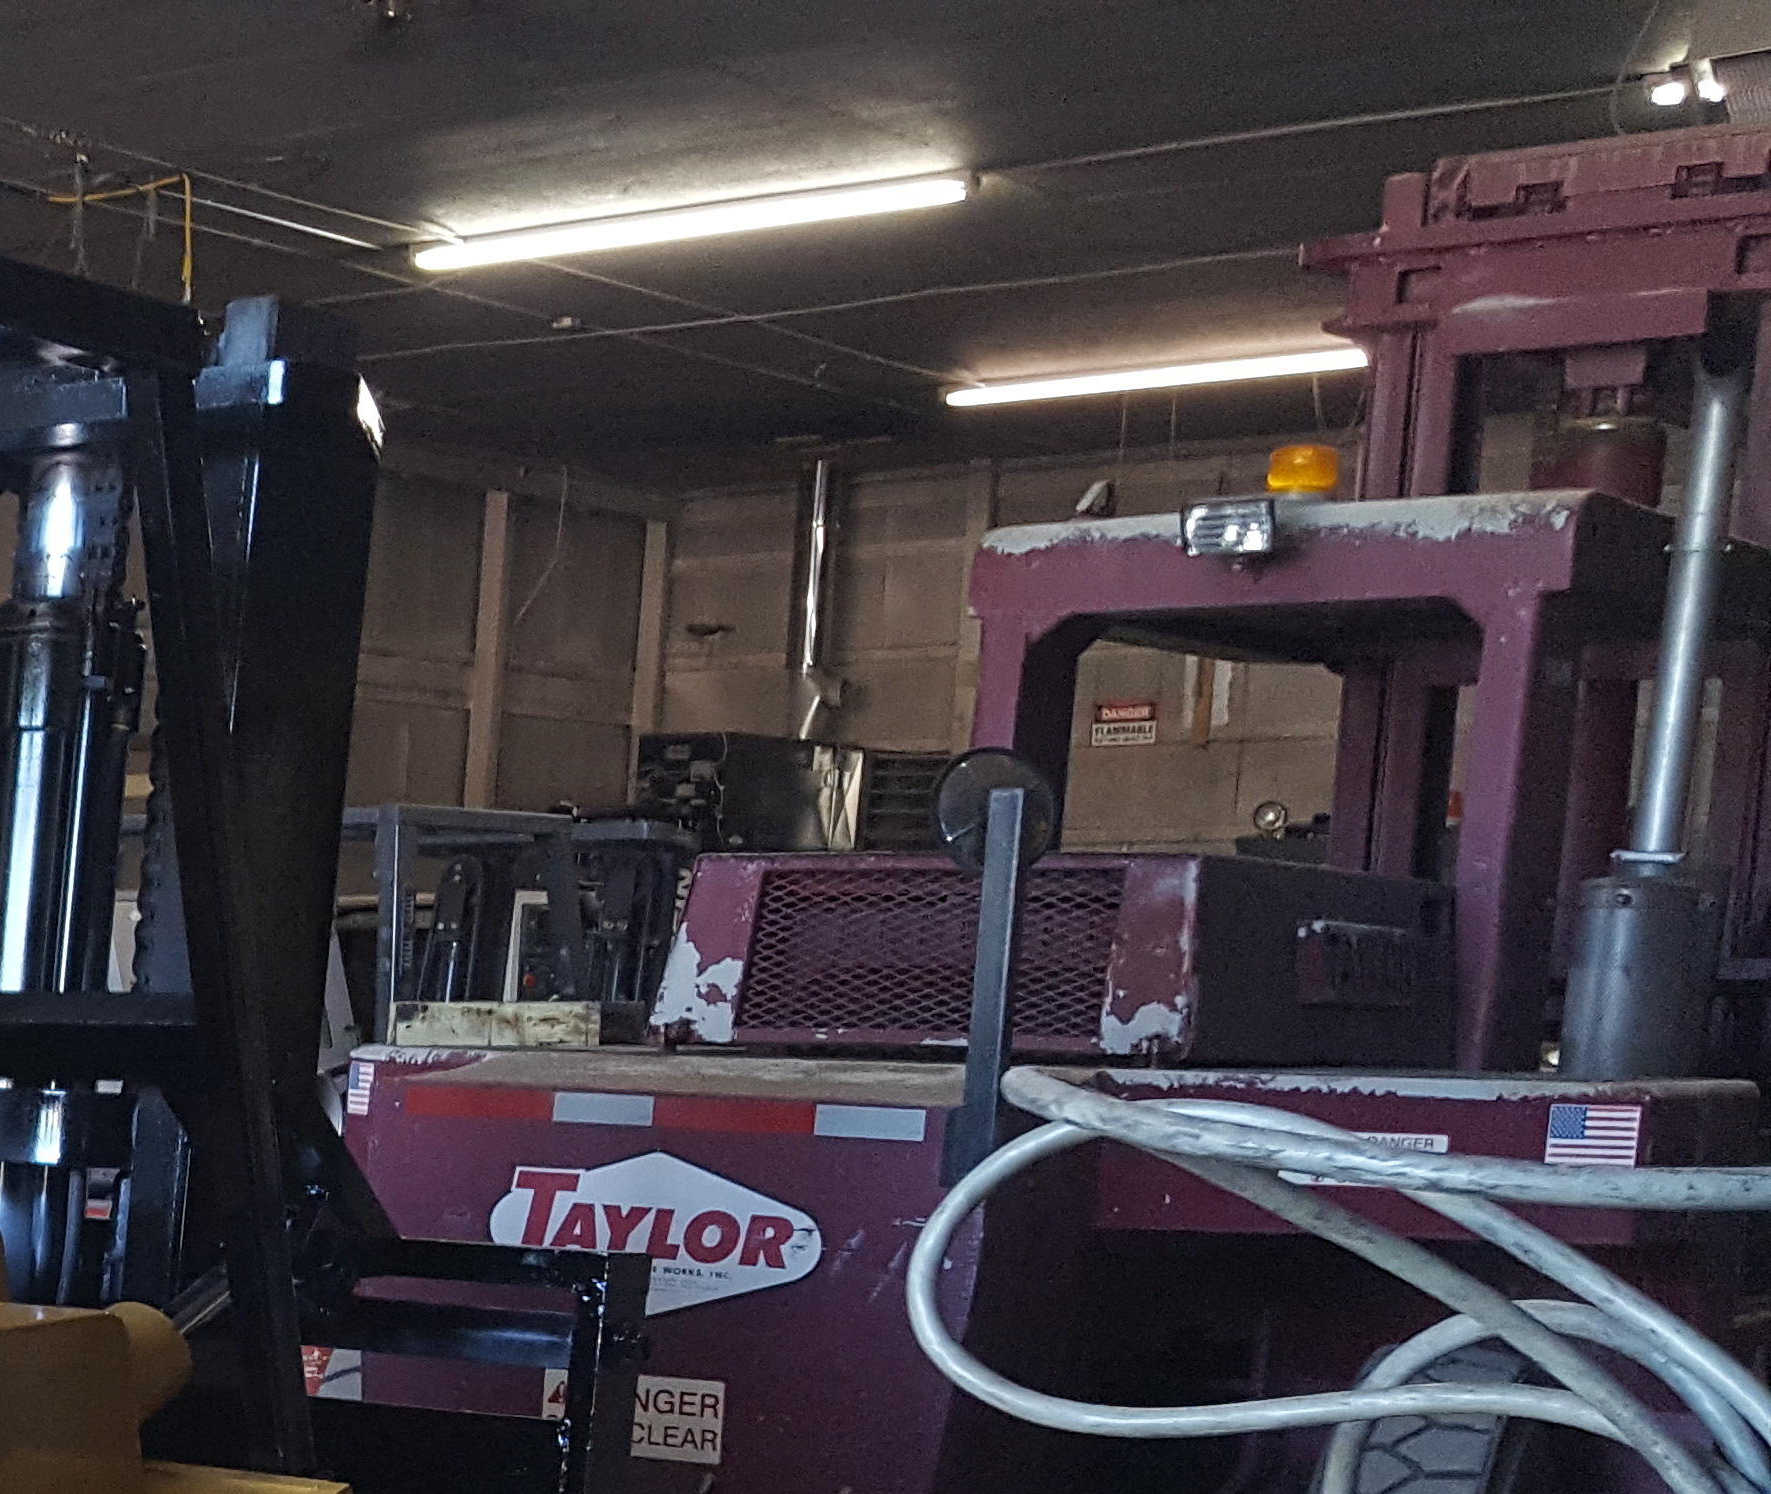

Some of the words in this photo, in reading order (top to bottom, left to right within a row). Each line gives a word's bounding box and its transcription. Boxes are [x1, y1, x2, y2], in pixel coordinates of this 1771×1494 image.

[516, 1171, 794, 1269] TAYLOR
[635, 1387, 720, 1419] NGER
[630, 1423, 718, 1451] CLEAR
